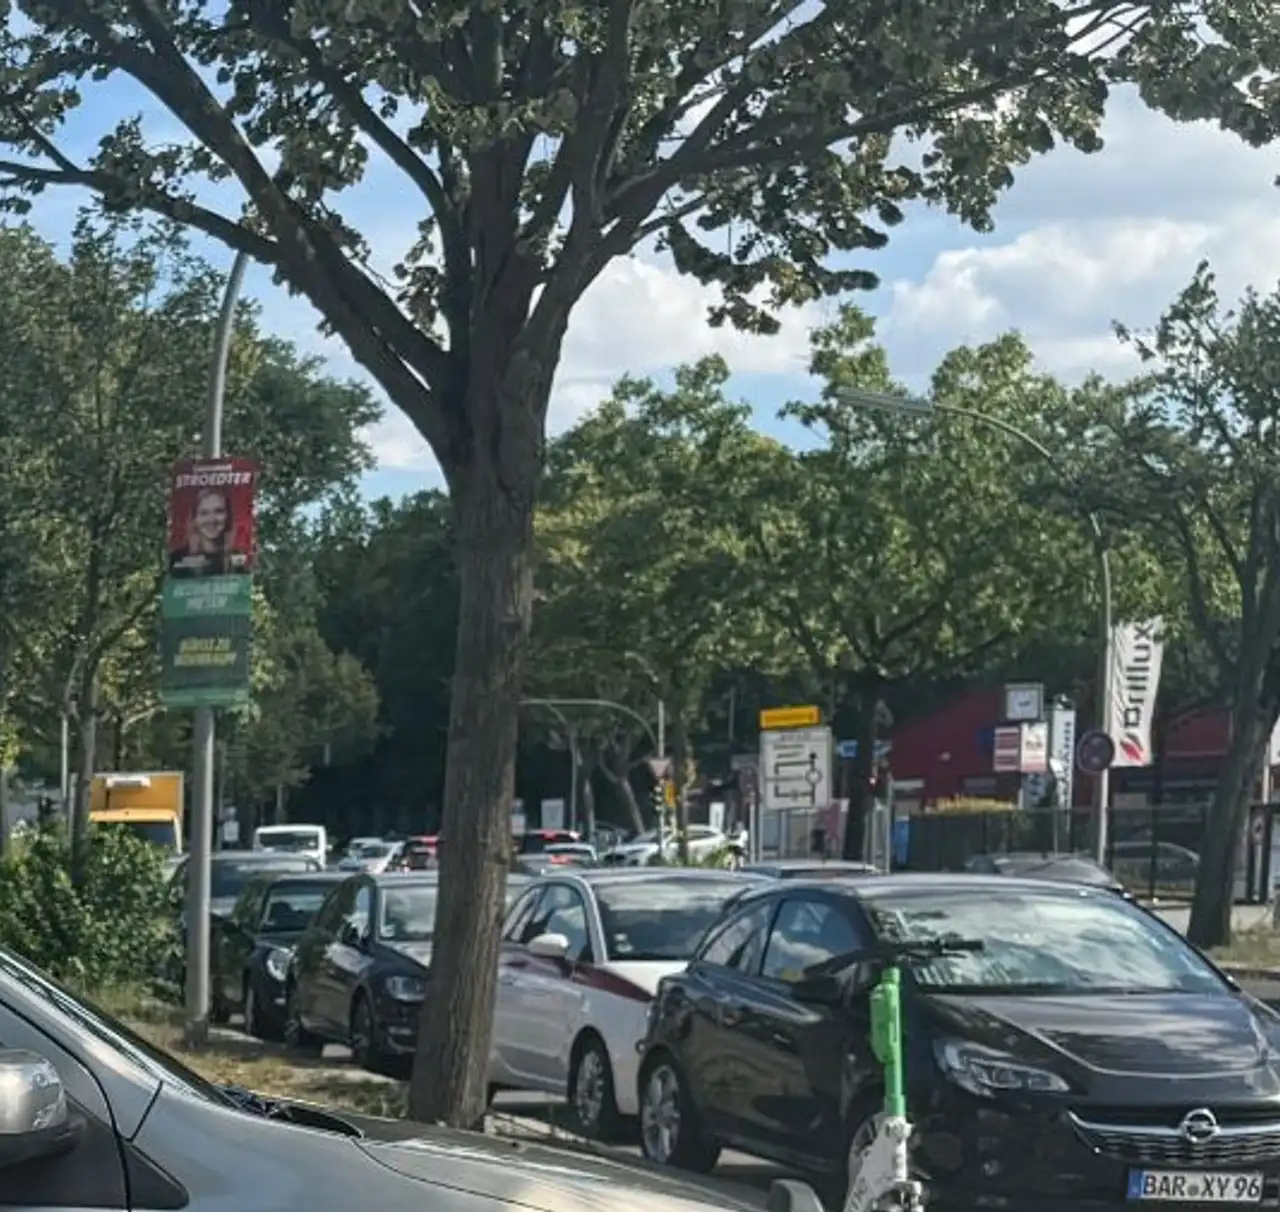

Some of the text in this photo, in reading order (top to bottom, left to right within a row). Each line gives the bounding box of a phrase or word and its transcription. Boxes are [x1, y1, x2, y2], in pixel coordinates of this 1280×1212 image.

[1143, 1174, 1260, 1199] BAR XY 96
